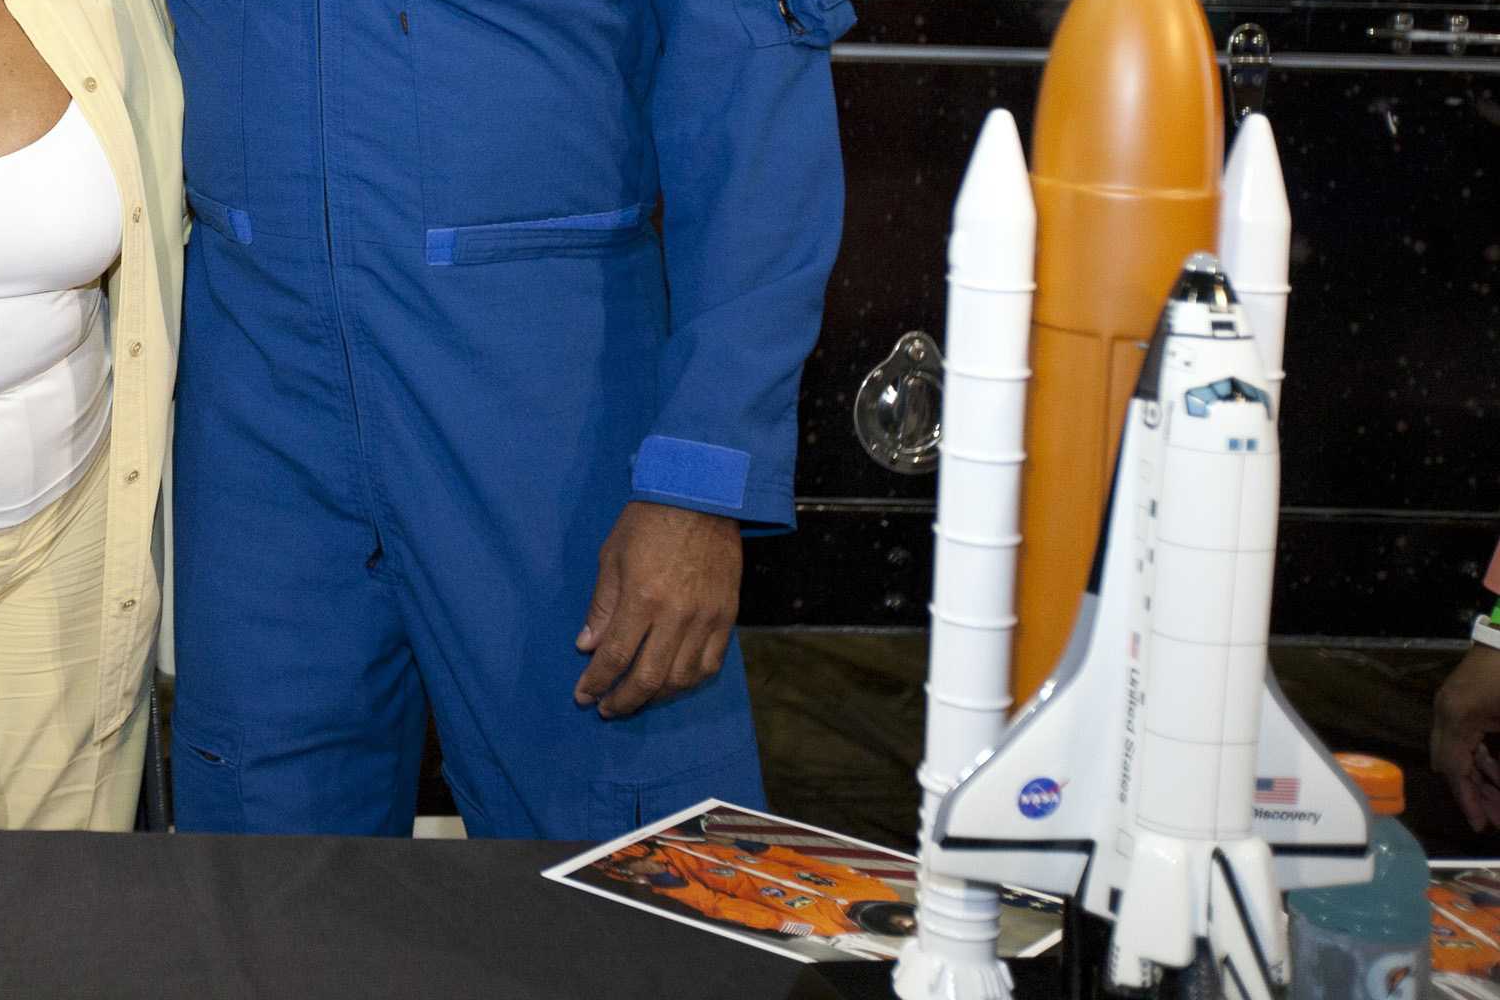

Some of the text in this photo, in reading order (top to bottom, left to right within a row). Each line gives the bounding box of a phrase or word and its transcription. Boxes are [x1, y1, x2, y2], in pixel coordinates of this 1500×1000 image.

[1119, 667, 1140, 803] United States
[1020, 792, 1061, 808] NASA
